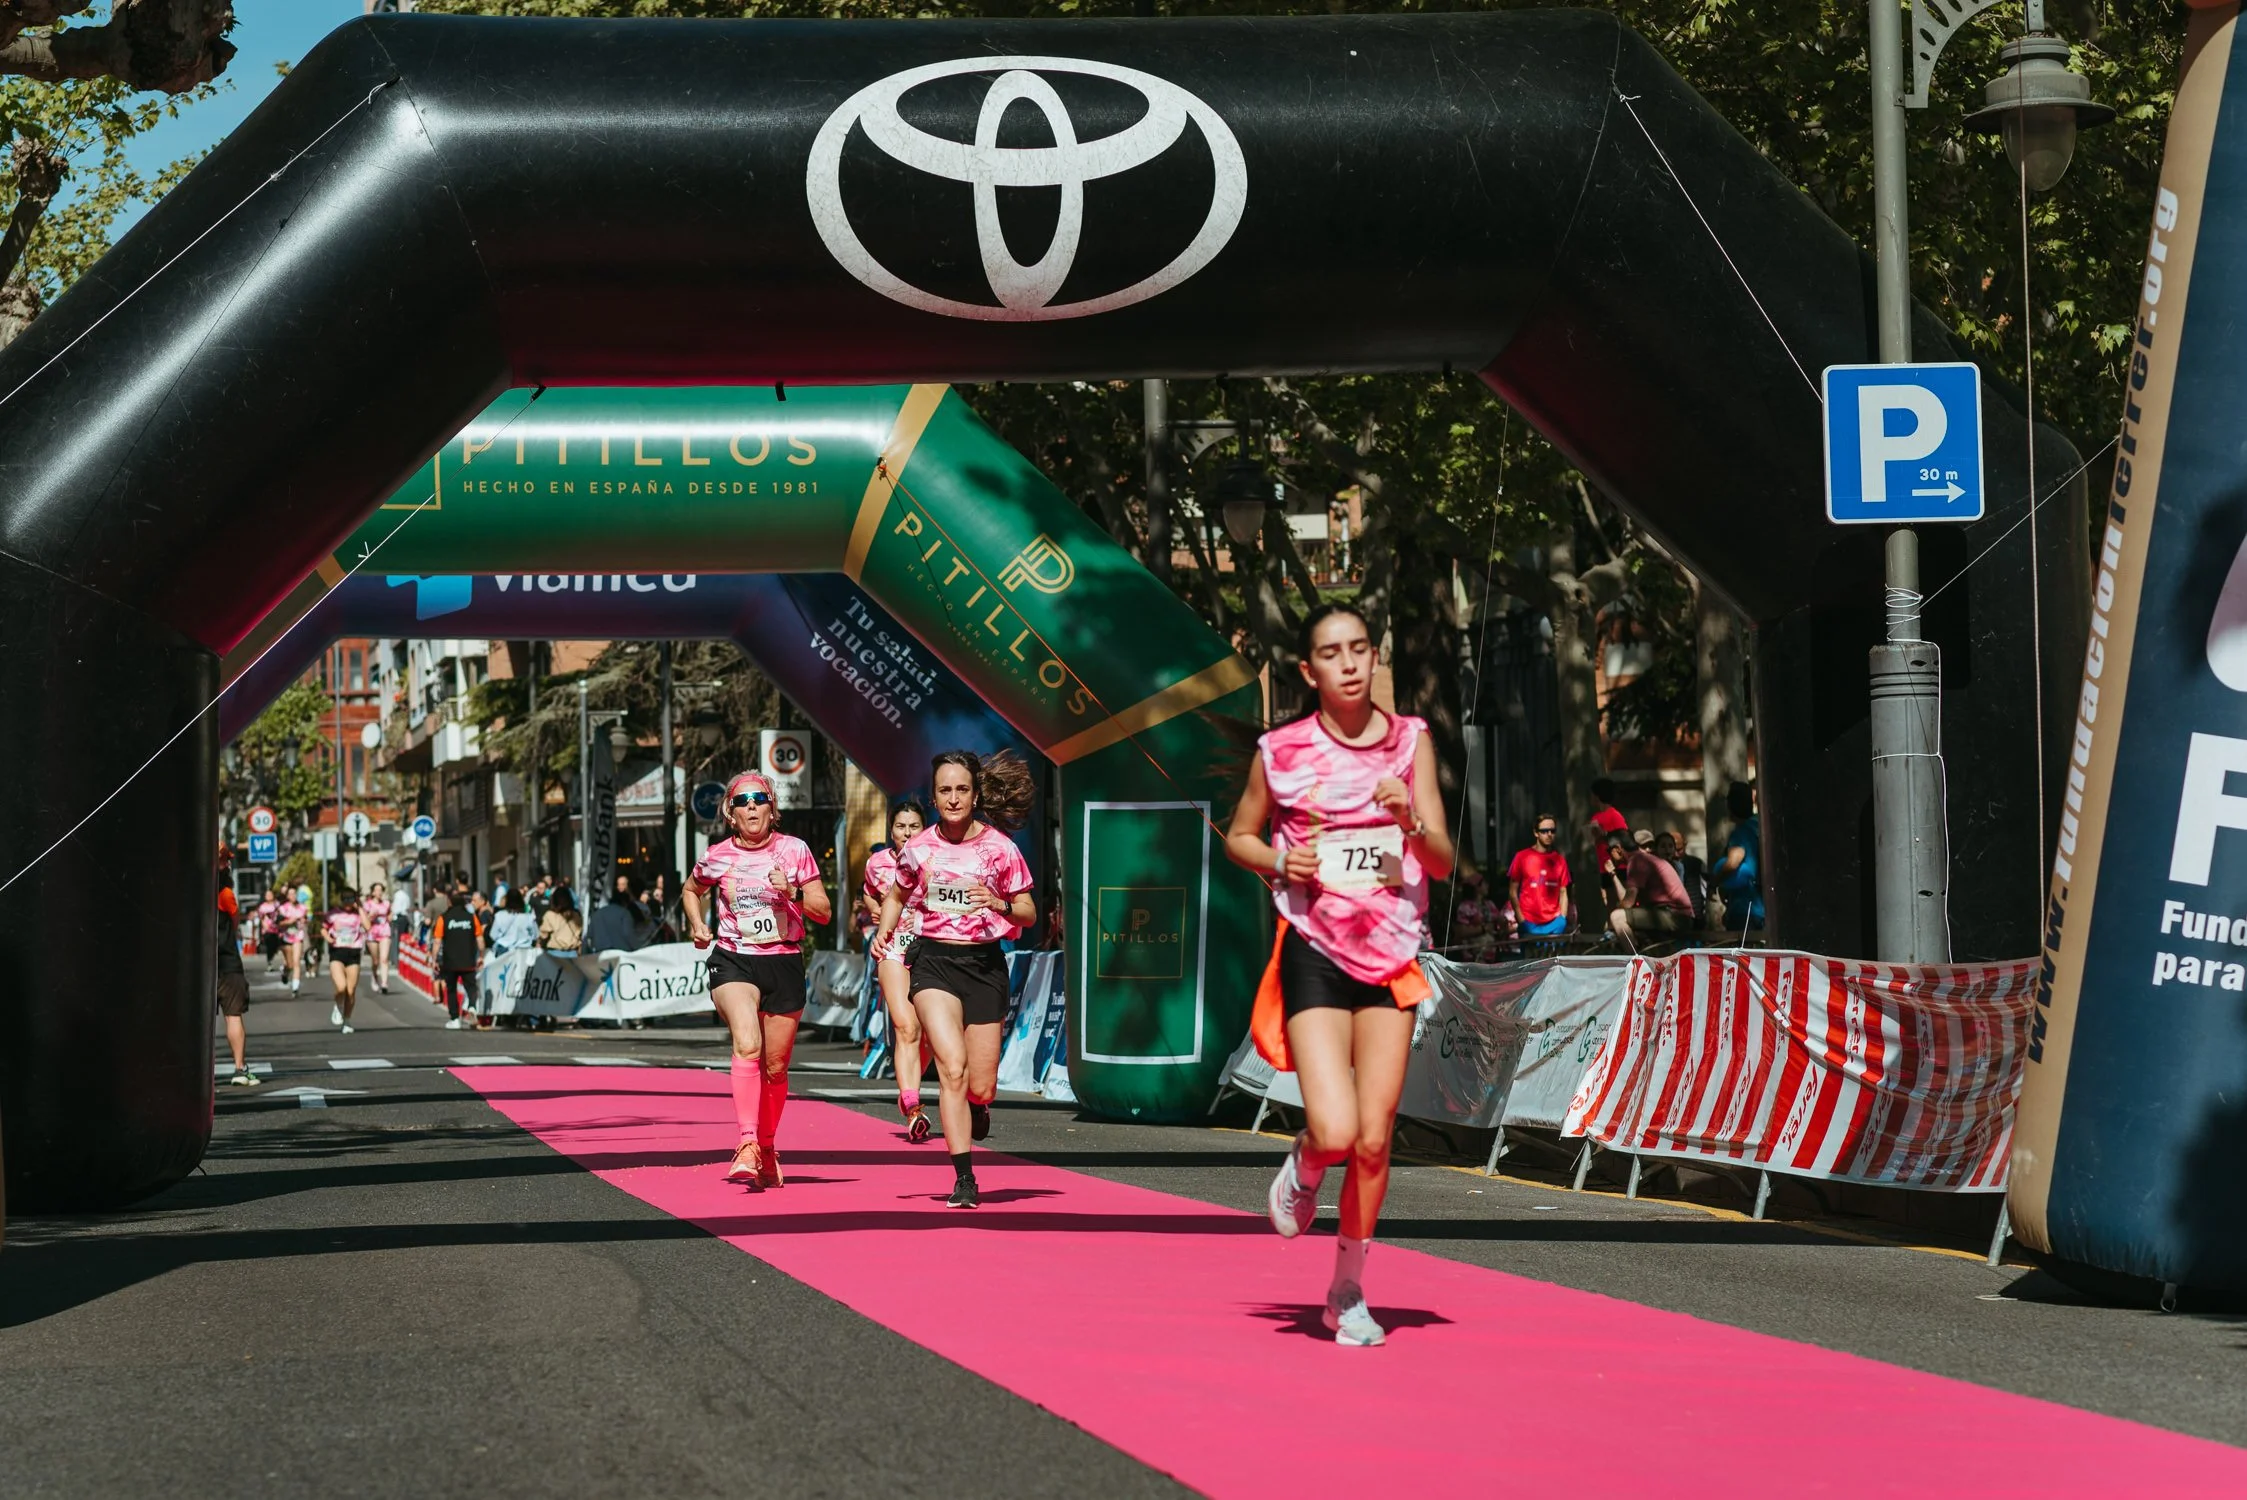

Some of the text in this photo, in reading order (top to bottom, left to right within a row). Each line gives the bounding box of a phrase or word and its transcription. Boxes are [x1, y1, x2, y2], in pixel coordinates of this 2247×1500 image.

[1858, 384, 1948, 503] P
[463, 479, 820, 494] HECHO EN ESPAÑA DESDE 1981
[1919, 468, 1959, 481] 30 m
[893, 511, 1093, 716] PITILLOS
[906, 562, 1048, 705] HECHO EN ESPAÑA
[826, 617, 923, 711] nuestra
[844, 596, 938, 695] Tu salud,
[810, 631, 903, 729] vocación.
[775, 748, 798, 763] 30
[1342, 846, 1382, 871] 725
[753, 918, 773, 935] 90
[1103, 932, 1179, 943] PITILLOS
[617, 959, 711, 1002] CaixaB
[2152, 951, 2245, 992] para
